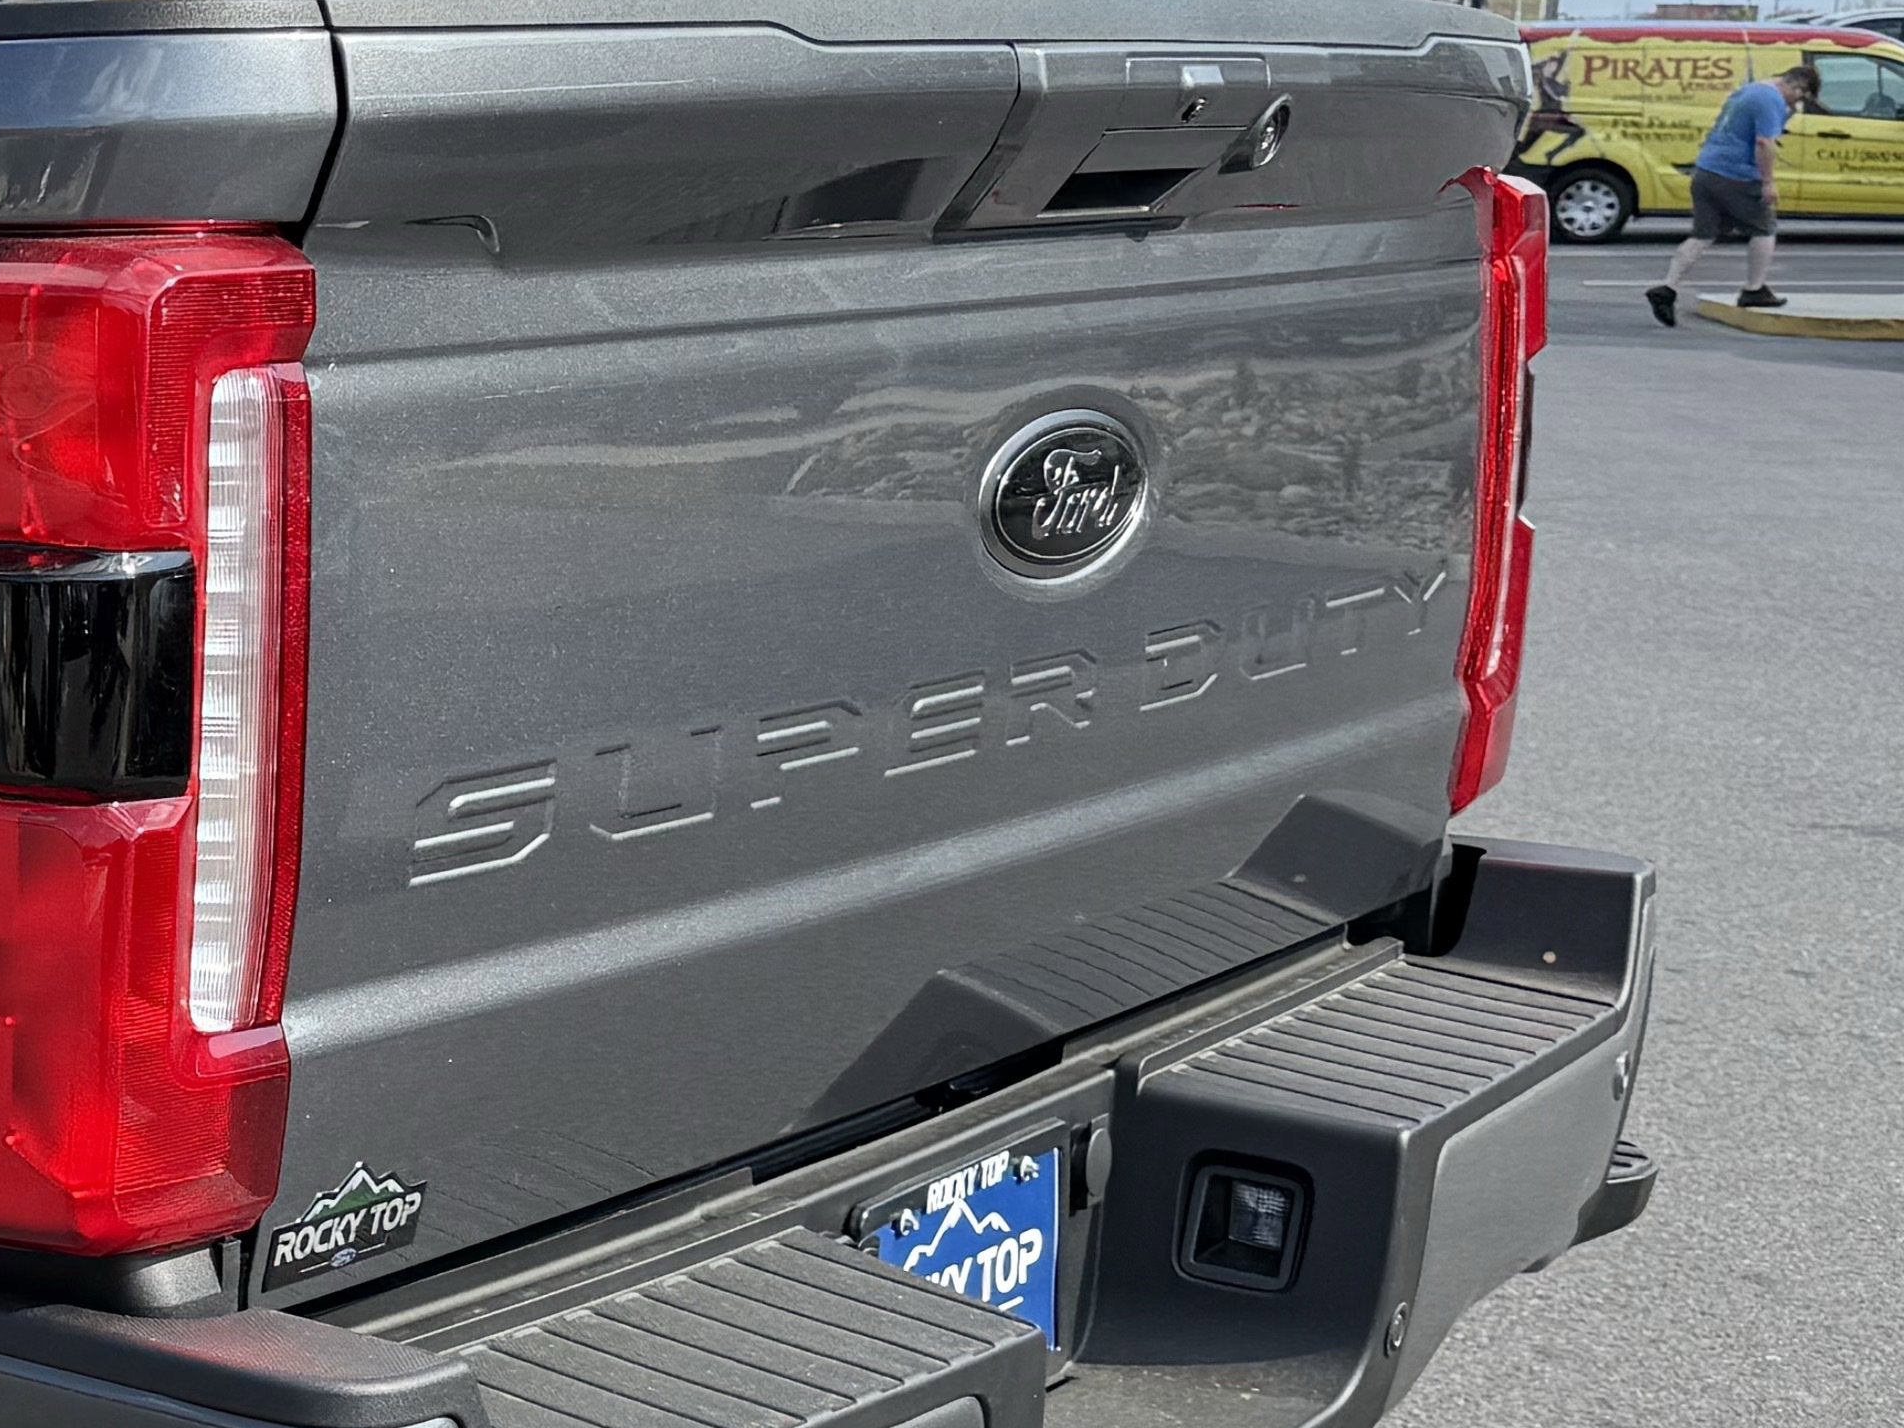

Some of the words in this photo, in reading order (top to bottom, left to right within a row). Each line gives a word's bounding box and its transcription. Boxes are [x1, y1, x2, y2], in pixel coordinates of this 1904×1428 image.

[1580, 56, 1734, 87] PIRATES
[1031, 448, 1120, 540] Ford
[407, 648, 1098, 888] SUPER
[1138, 569, 1452, 714] DUTY
[925, 1164, 979, 1214] ROCKY
[980, 1150, 1010, 1189] TOP
[273, 1207, 368, 1267] ROCKY
[369, 1191, 422, 1236] TOP
[976, 1228, 1043, 1302] TOP
